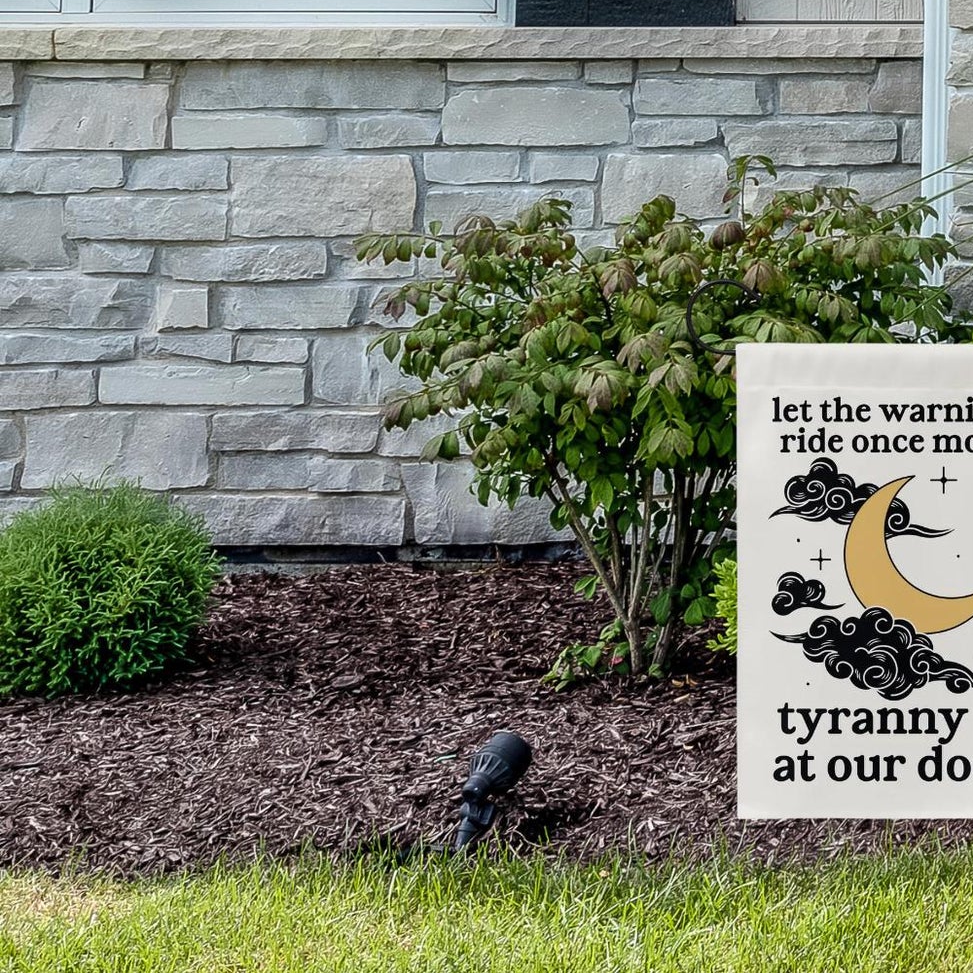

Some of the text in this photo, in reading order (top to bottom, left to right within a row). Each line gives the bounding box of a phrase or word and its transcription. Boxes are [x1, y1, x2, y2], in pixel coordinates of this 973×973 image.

[772, 397, 812, 423] let
[820, 397, 871, 423] the
[780, 427, 844, 454] ride
[852, 434, 925, 454] once
[777, 700, 969, 745] tyranny
[773, 750, 816, 782] at
[827, 755, 907, 782] our
